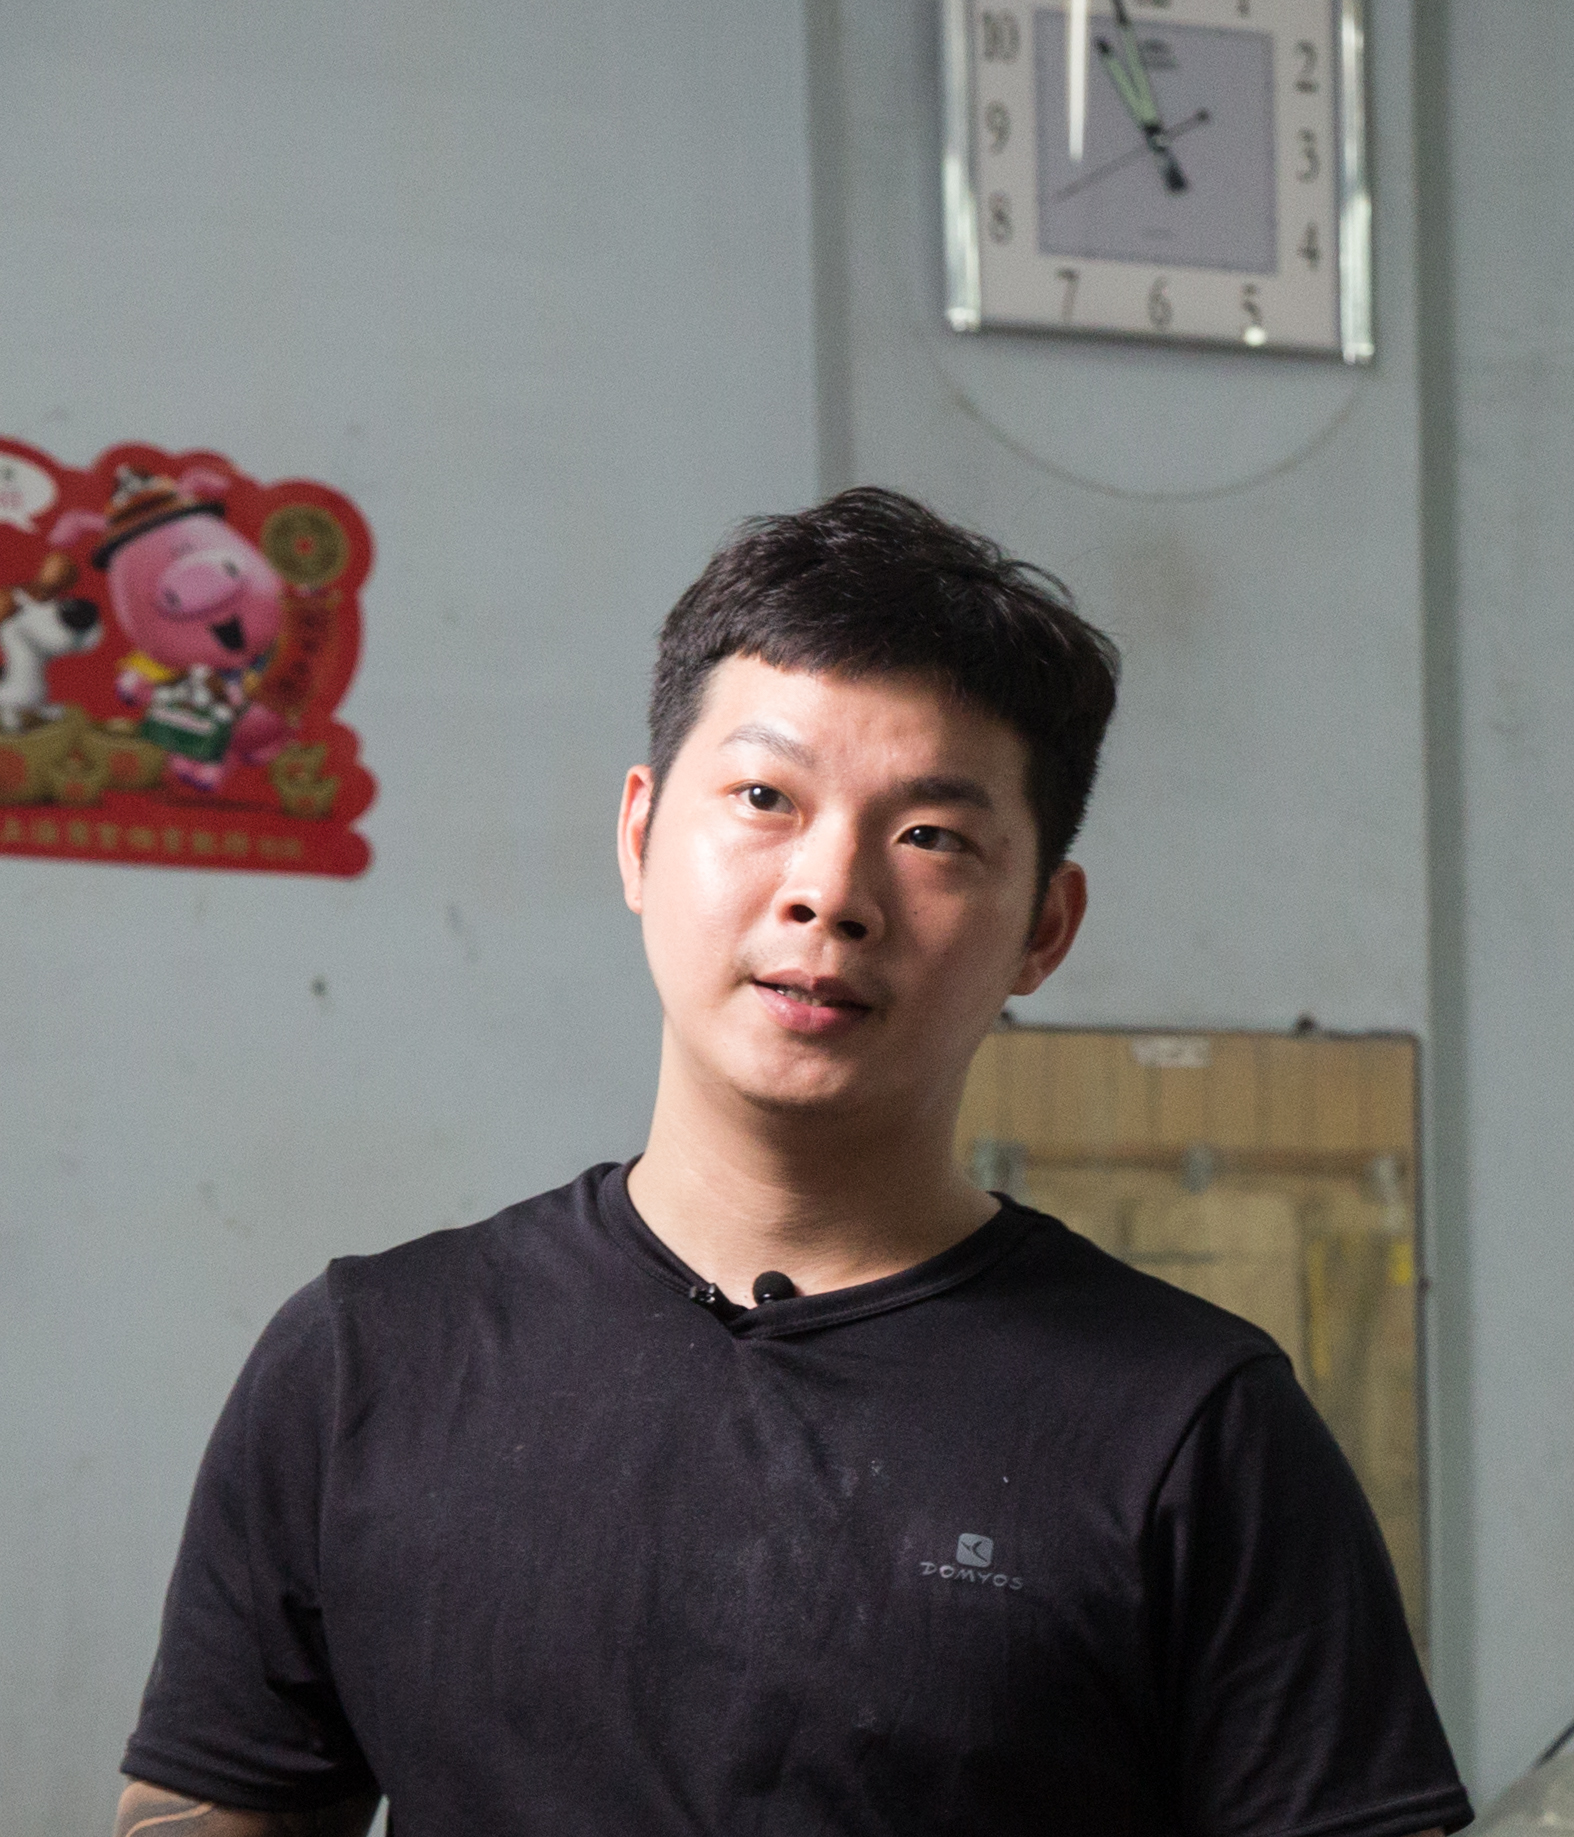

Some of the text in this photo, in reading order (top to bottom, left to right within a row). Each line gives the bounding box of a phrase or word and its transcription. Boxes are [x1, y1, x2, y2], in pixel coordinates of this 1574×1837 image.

[1295, 40, 1318, 94] 2
[986, 101, 1011, 155] 9
[1297, 128, 1320, 183] 3
[988, 191, 1013, 245] 8
[1298, 221, 1321, 271] 4
[1056, 266, 1080, 324] 7
[1147, 276, 1173, 328] 6
[919, 1561, 1024, 1590] DOMYOS
